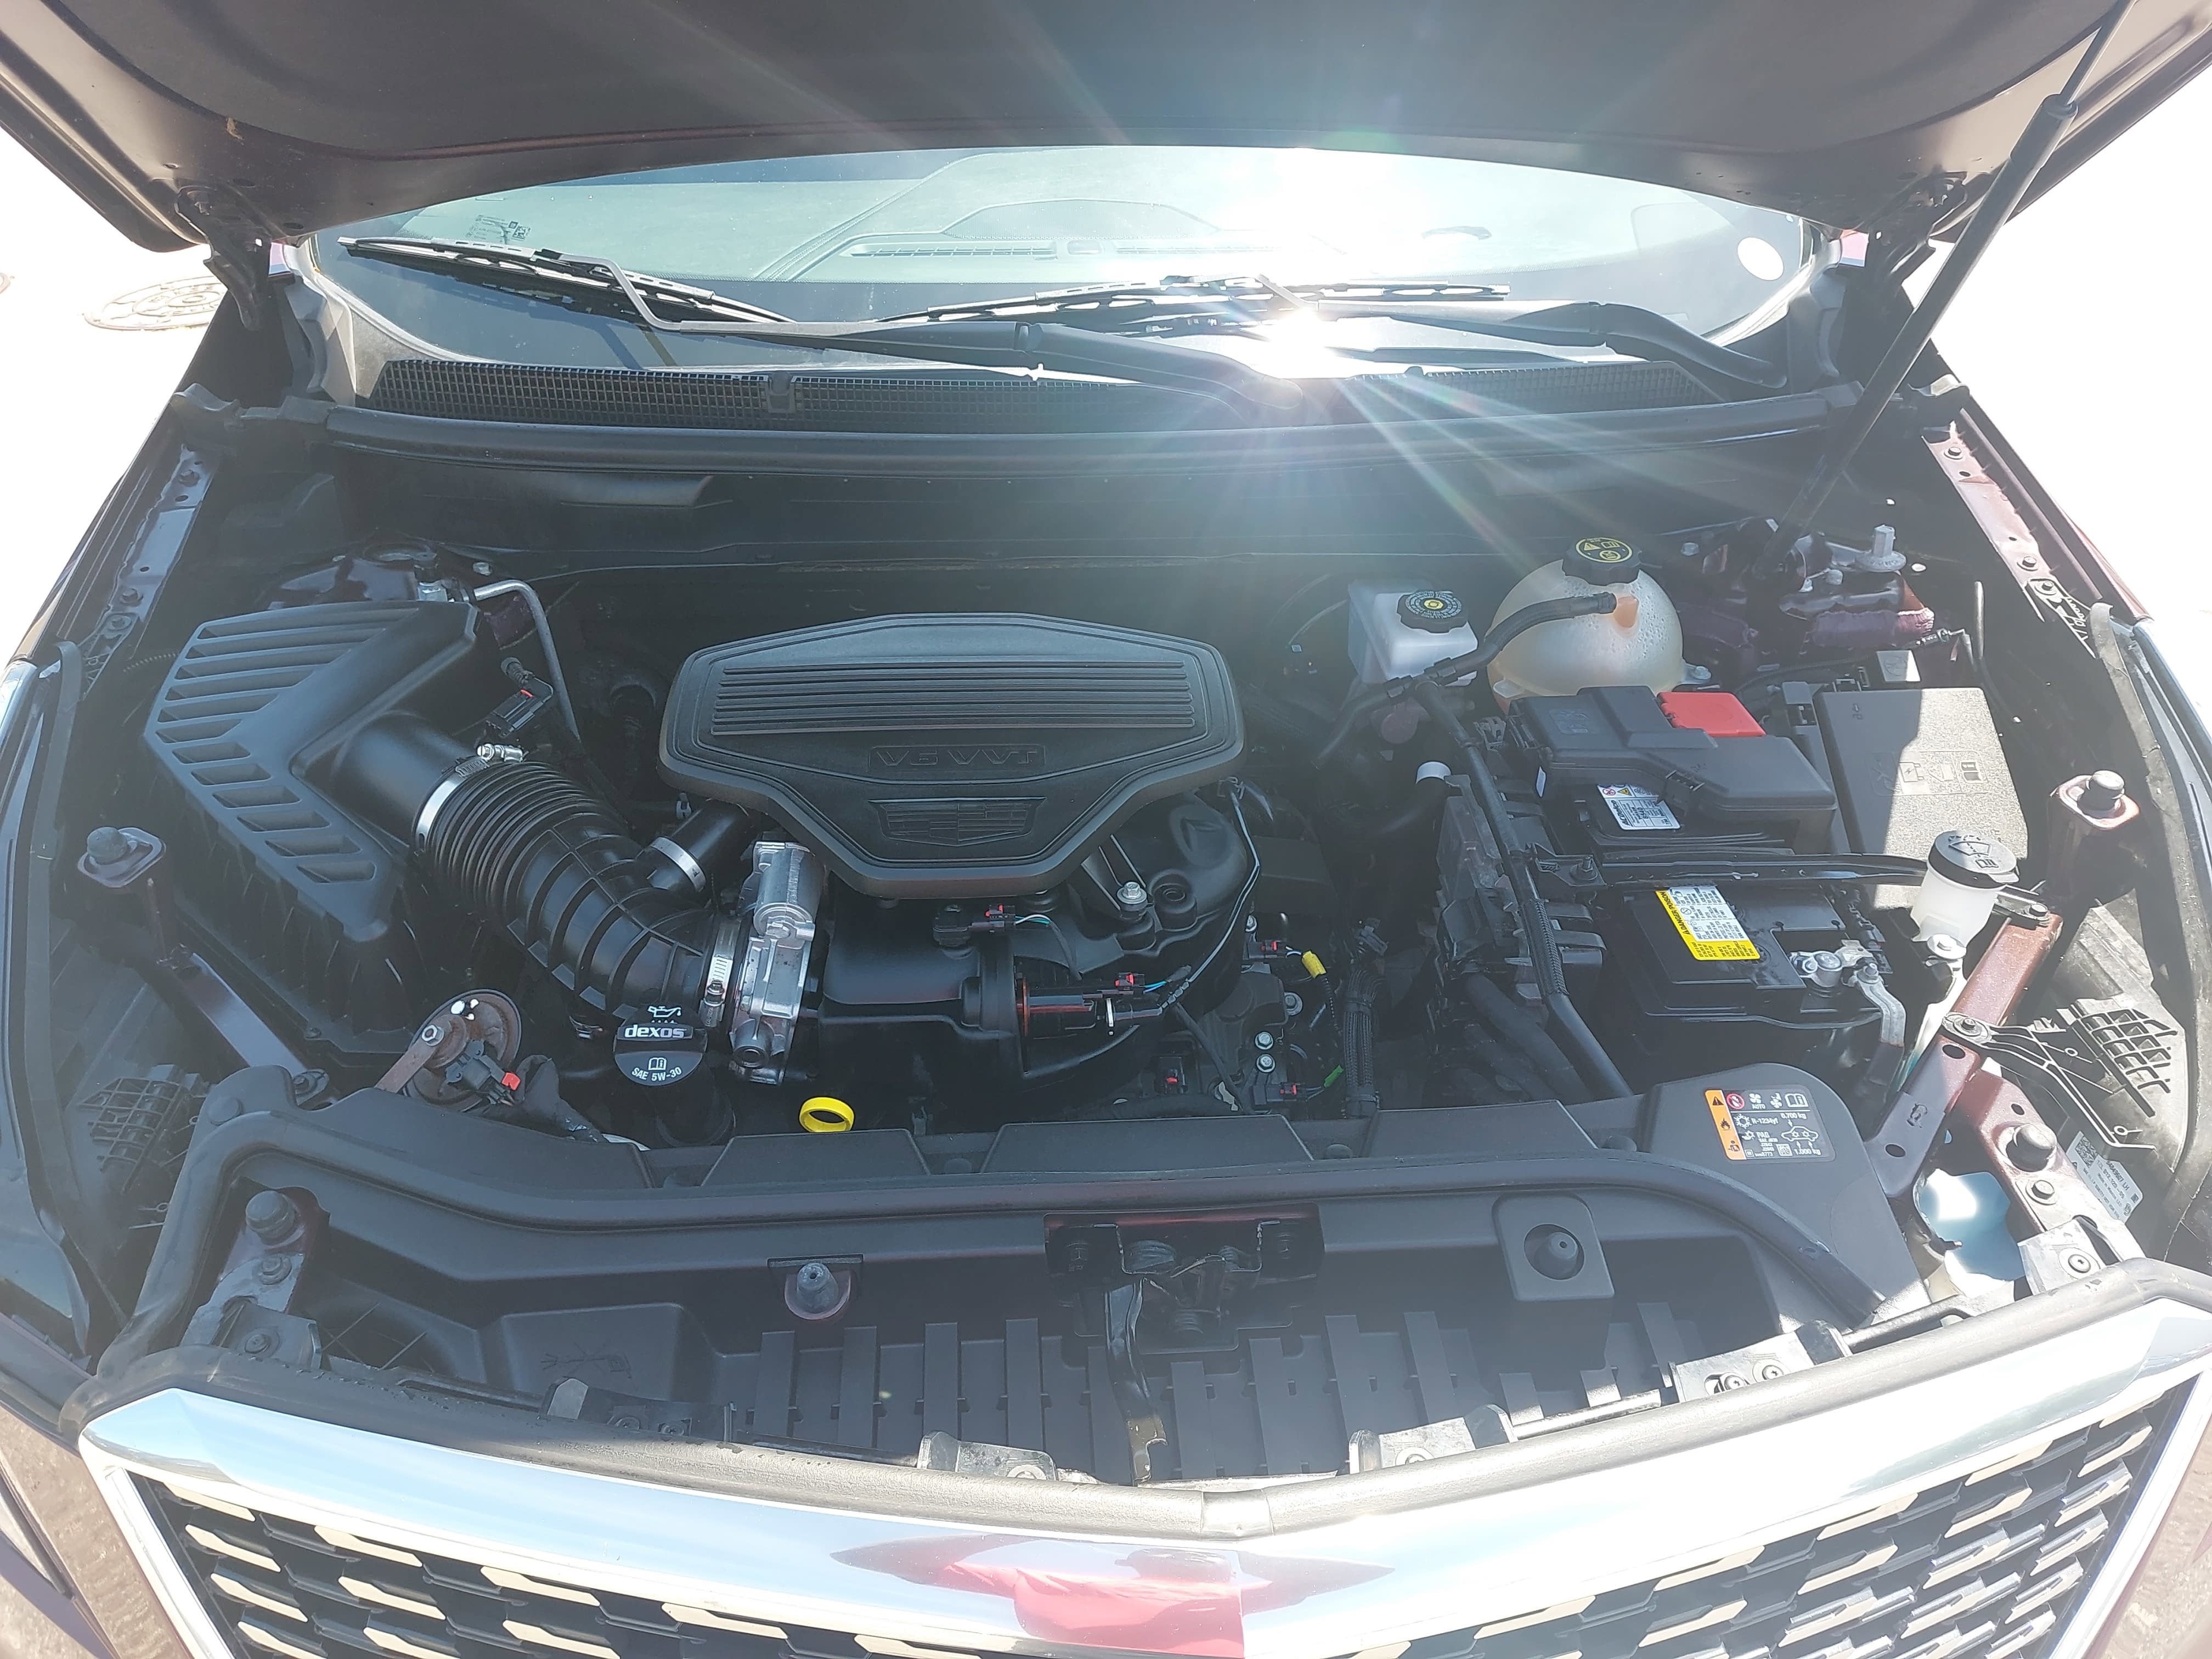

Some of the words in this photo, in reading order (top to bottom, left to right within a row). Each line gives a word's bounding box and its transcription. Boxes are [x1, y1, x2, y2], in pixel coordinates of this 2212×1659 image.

[876, 749, 939, 766] V6
[947, 748, 1038, 765] VVT
[1611, 800, 1631, 826] ACDelco
[624, 1024, 686, 1038] dexos
[631, 1067, 649, 1080] SAE
[651, 1066, 682, 1082] 5W-30
